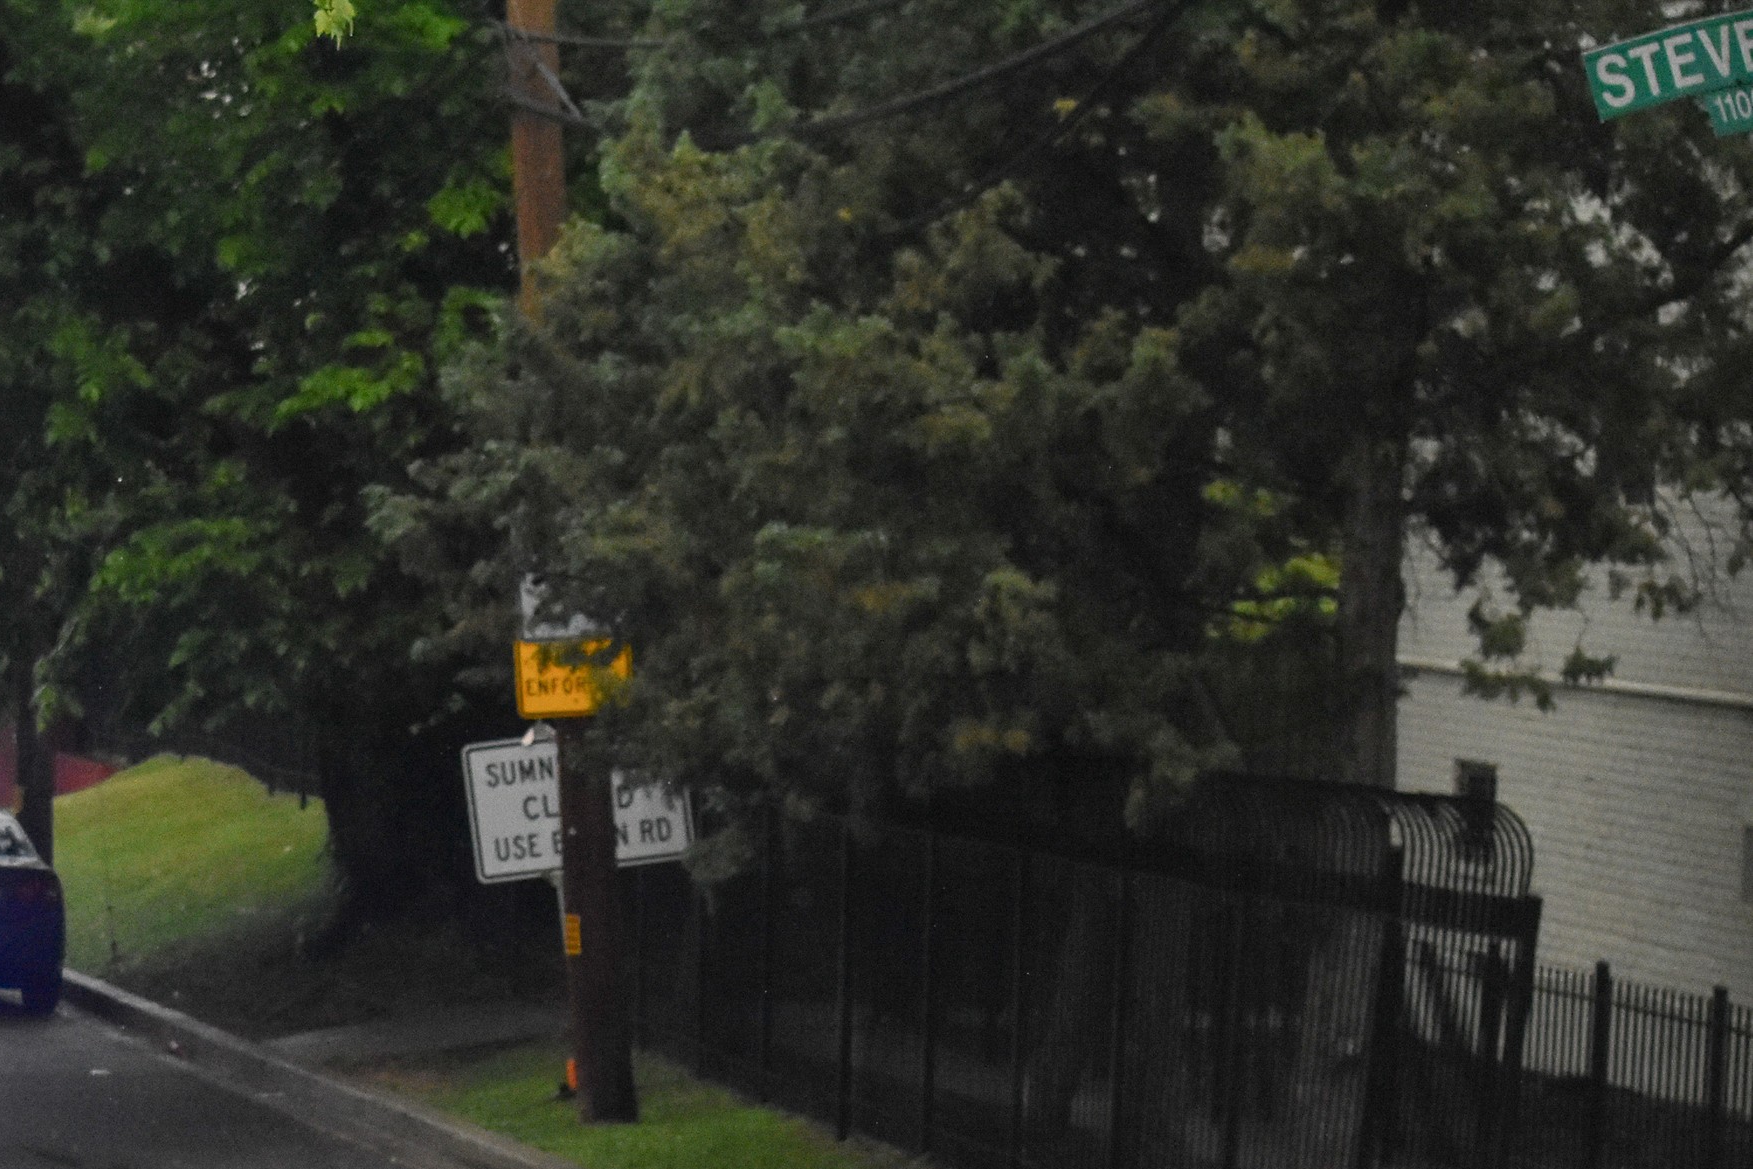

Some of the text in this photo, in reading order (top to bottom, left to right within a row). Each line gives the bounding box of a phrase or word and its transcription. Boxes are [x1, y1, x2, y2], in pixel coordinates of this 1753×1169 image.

[1714, 89, 1753, 123] 110
[494, 832, 542, 862] USE
[640, 818, 672, 844] RD
